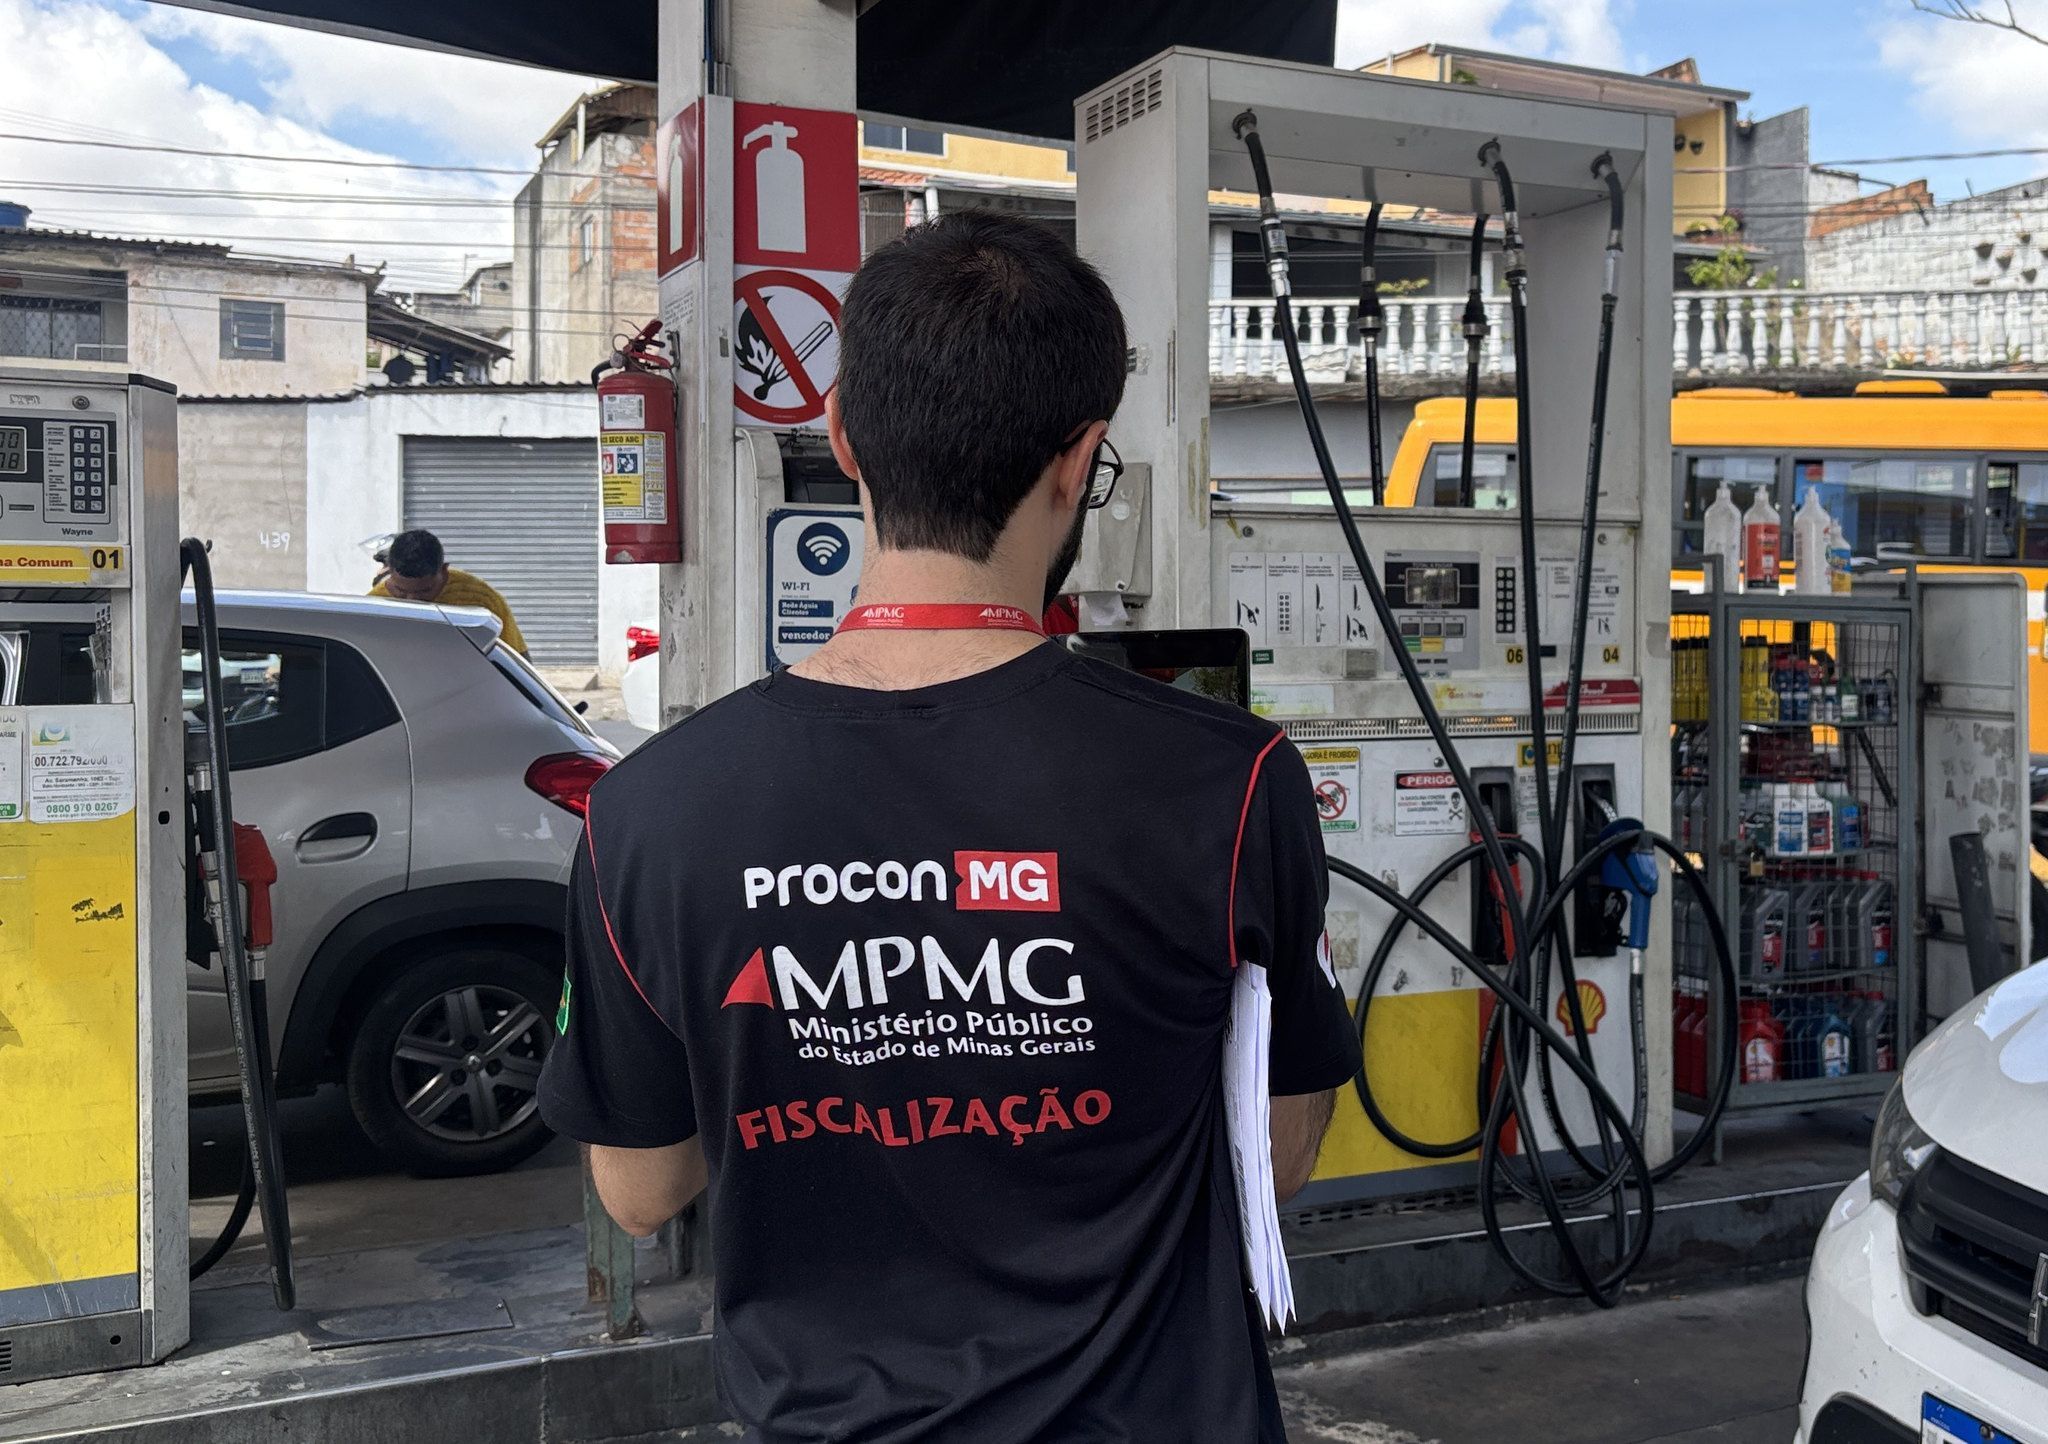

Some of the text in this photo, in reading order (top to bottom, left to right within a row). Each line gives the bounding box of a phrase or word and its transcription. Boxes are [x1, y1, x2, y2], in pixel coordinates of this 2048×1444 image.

[62, 528, 93, 536] Wayne
[260, 531, 290, 554] 439
[18, 557, 73, 567] Comum
[93, 549, 119, 569] 01
[782, 582, 810, 591] WI-FI
[869, 607, 904, 618] MPMG
[989, 608, 1023, 620] MPMG
[782, 631, 830, 640] vencedor
[1507, 649, 1523, 663] 06
[1603, 648, 1619, 662] 04
[1407, 776, 1454, 785] PERIGO
[46, 804, 71, 813] 0800
[73, 803, 92, 812] 970
[969, 859, 1049, 902] MG
[772, 936, 1085, 1010] MPMG
[788, 1010, 1093, 1044] Ministério Público
[799, 1037, 1095, 1066] do Estado de Minas Gerais
[736, 1087, 1112, 1150] FISCALIZAÇÃO
